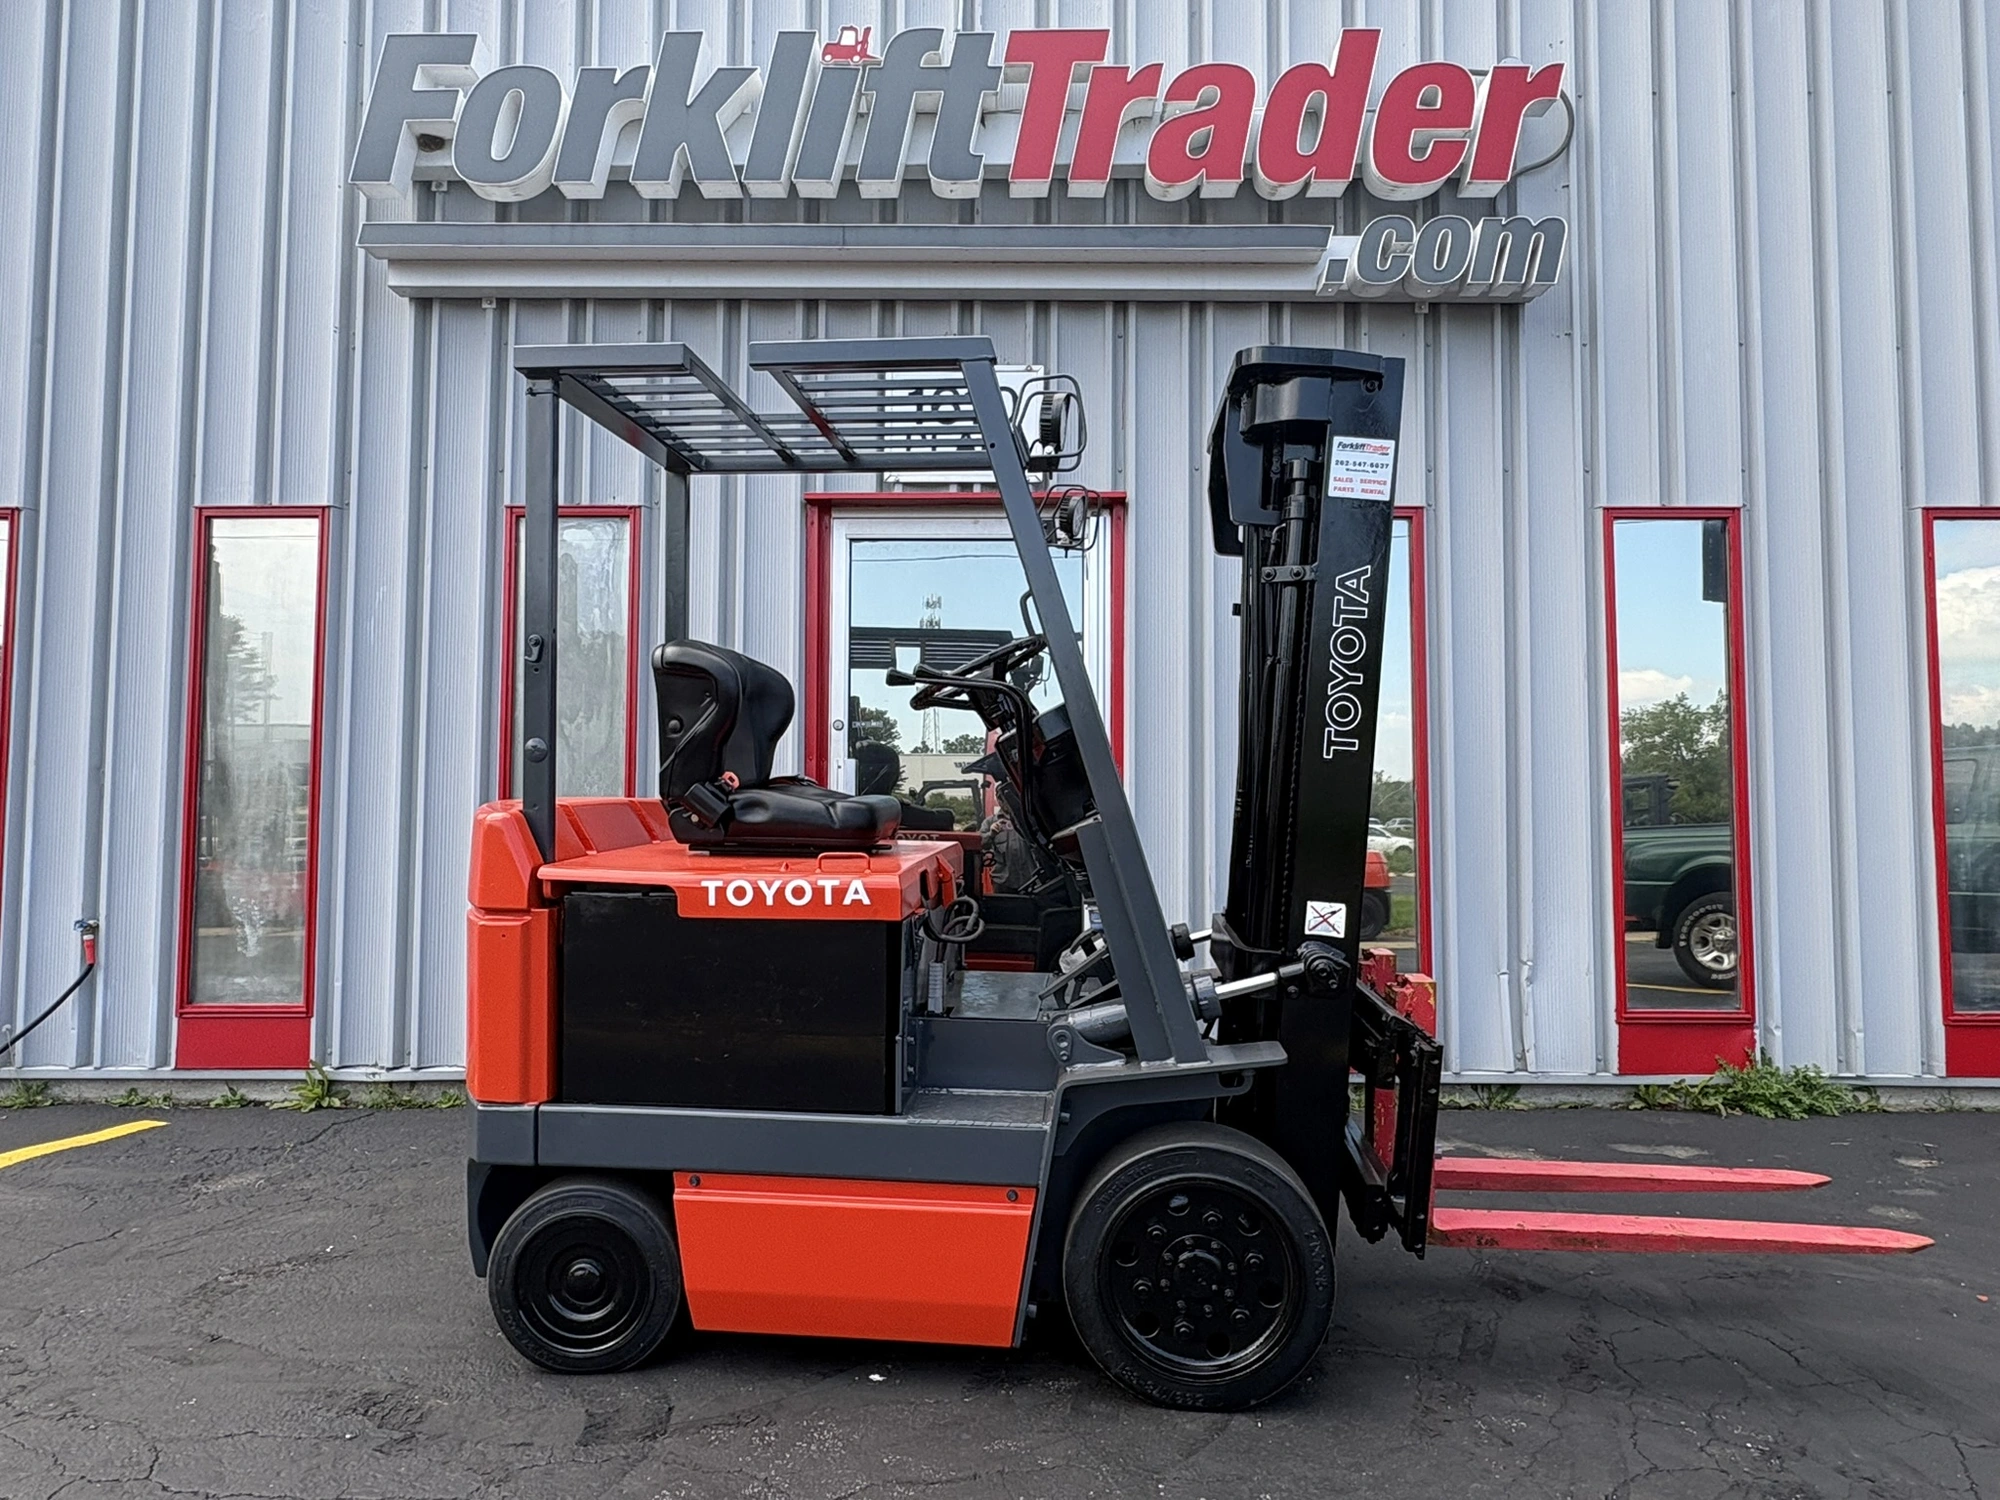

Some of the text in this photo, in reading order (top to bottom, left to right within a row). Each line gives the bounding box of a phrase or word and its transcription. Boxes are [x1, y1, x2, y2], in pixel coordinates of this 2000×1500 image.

[1323, 214, 1568, 290] .com
[1360, 478, 1388, 486] SERVICE
[1361, 488, 1386, 496] RENTAL
[1323, 565, 1371, 759] TOYOTA
[701, 879, 871, 907] TOYOTA
